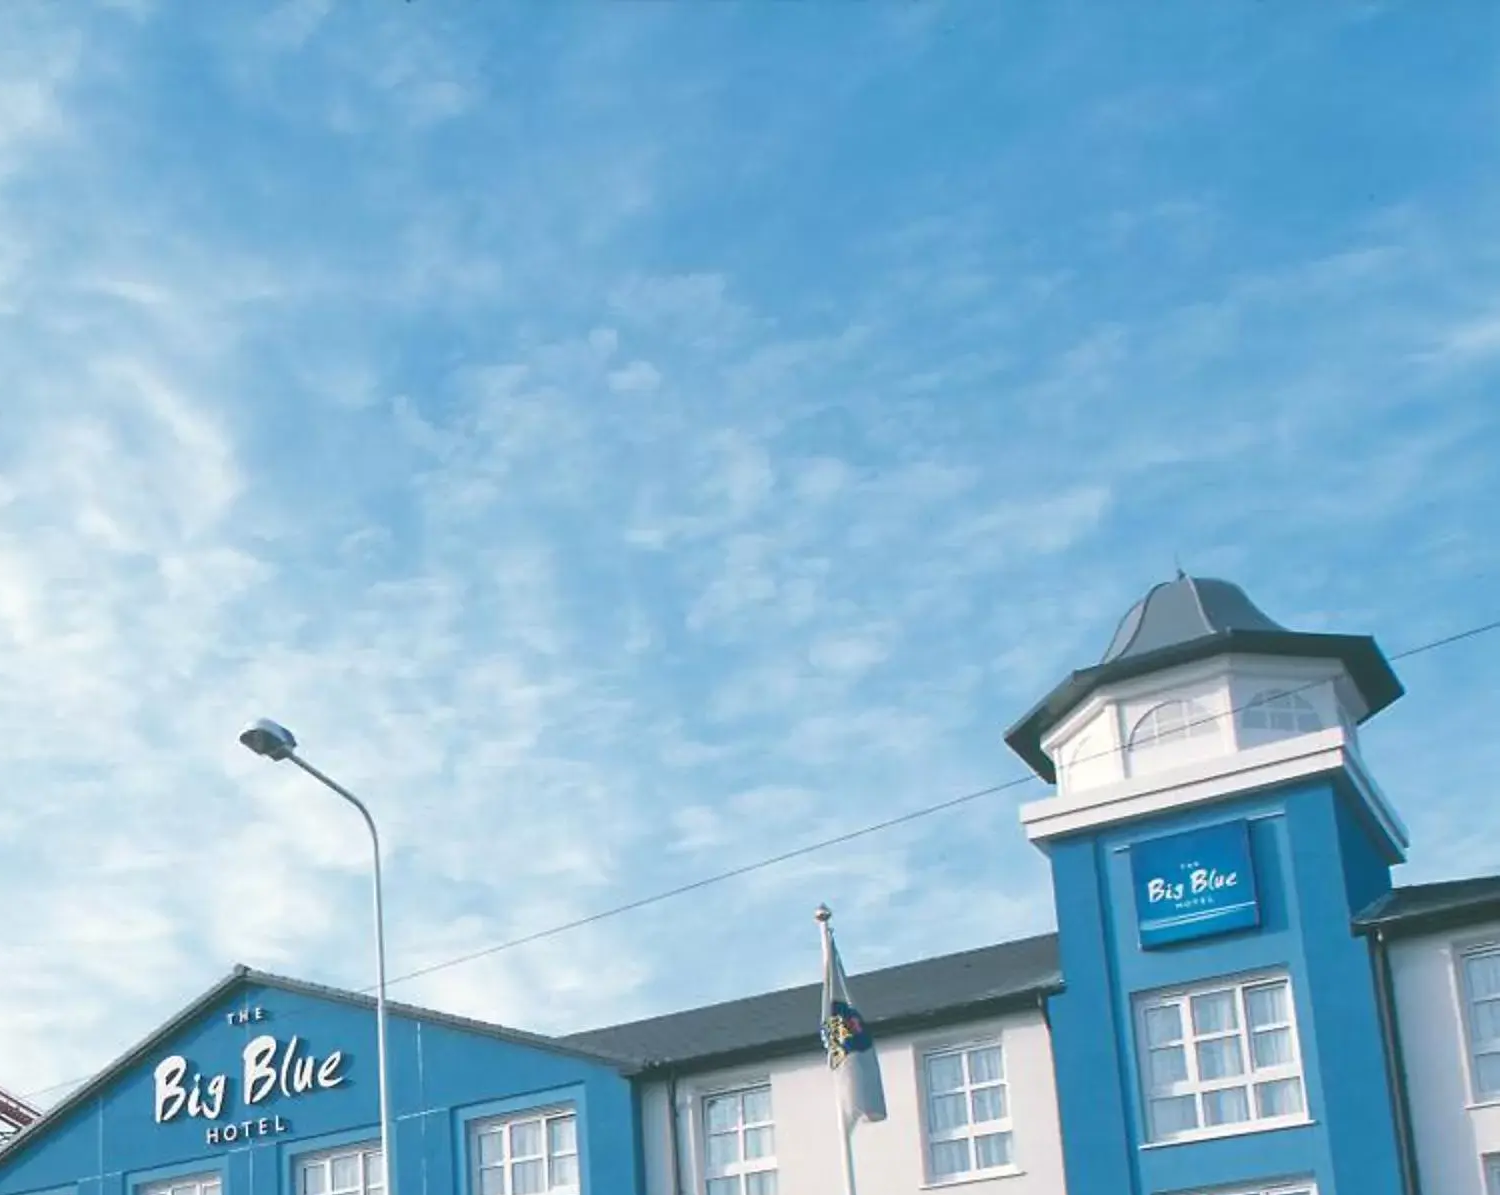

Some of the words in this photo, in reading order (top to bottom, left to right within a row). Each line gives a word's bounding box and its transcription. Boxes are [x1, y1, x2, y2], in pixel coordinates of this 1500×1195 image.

[1147, 877, 1185, 903] Big
[1189, 868, 1238, 894] Blue
[227, 1007, 265, 1026] THE
[153, 1054, 228, 1123] Big
[242, 1034, 345, 1105] Blue
[205, 1115, 286, 1145] HOTEL
